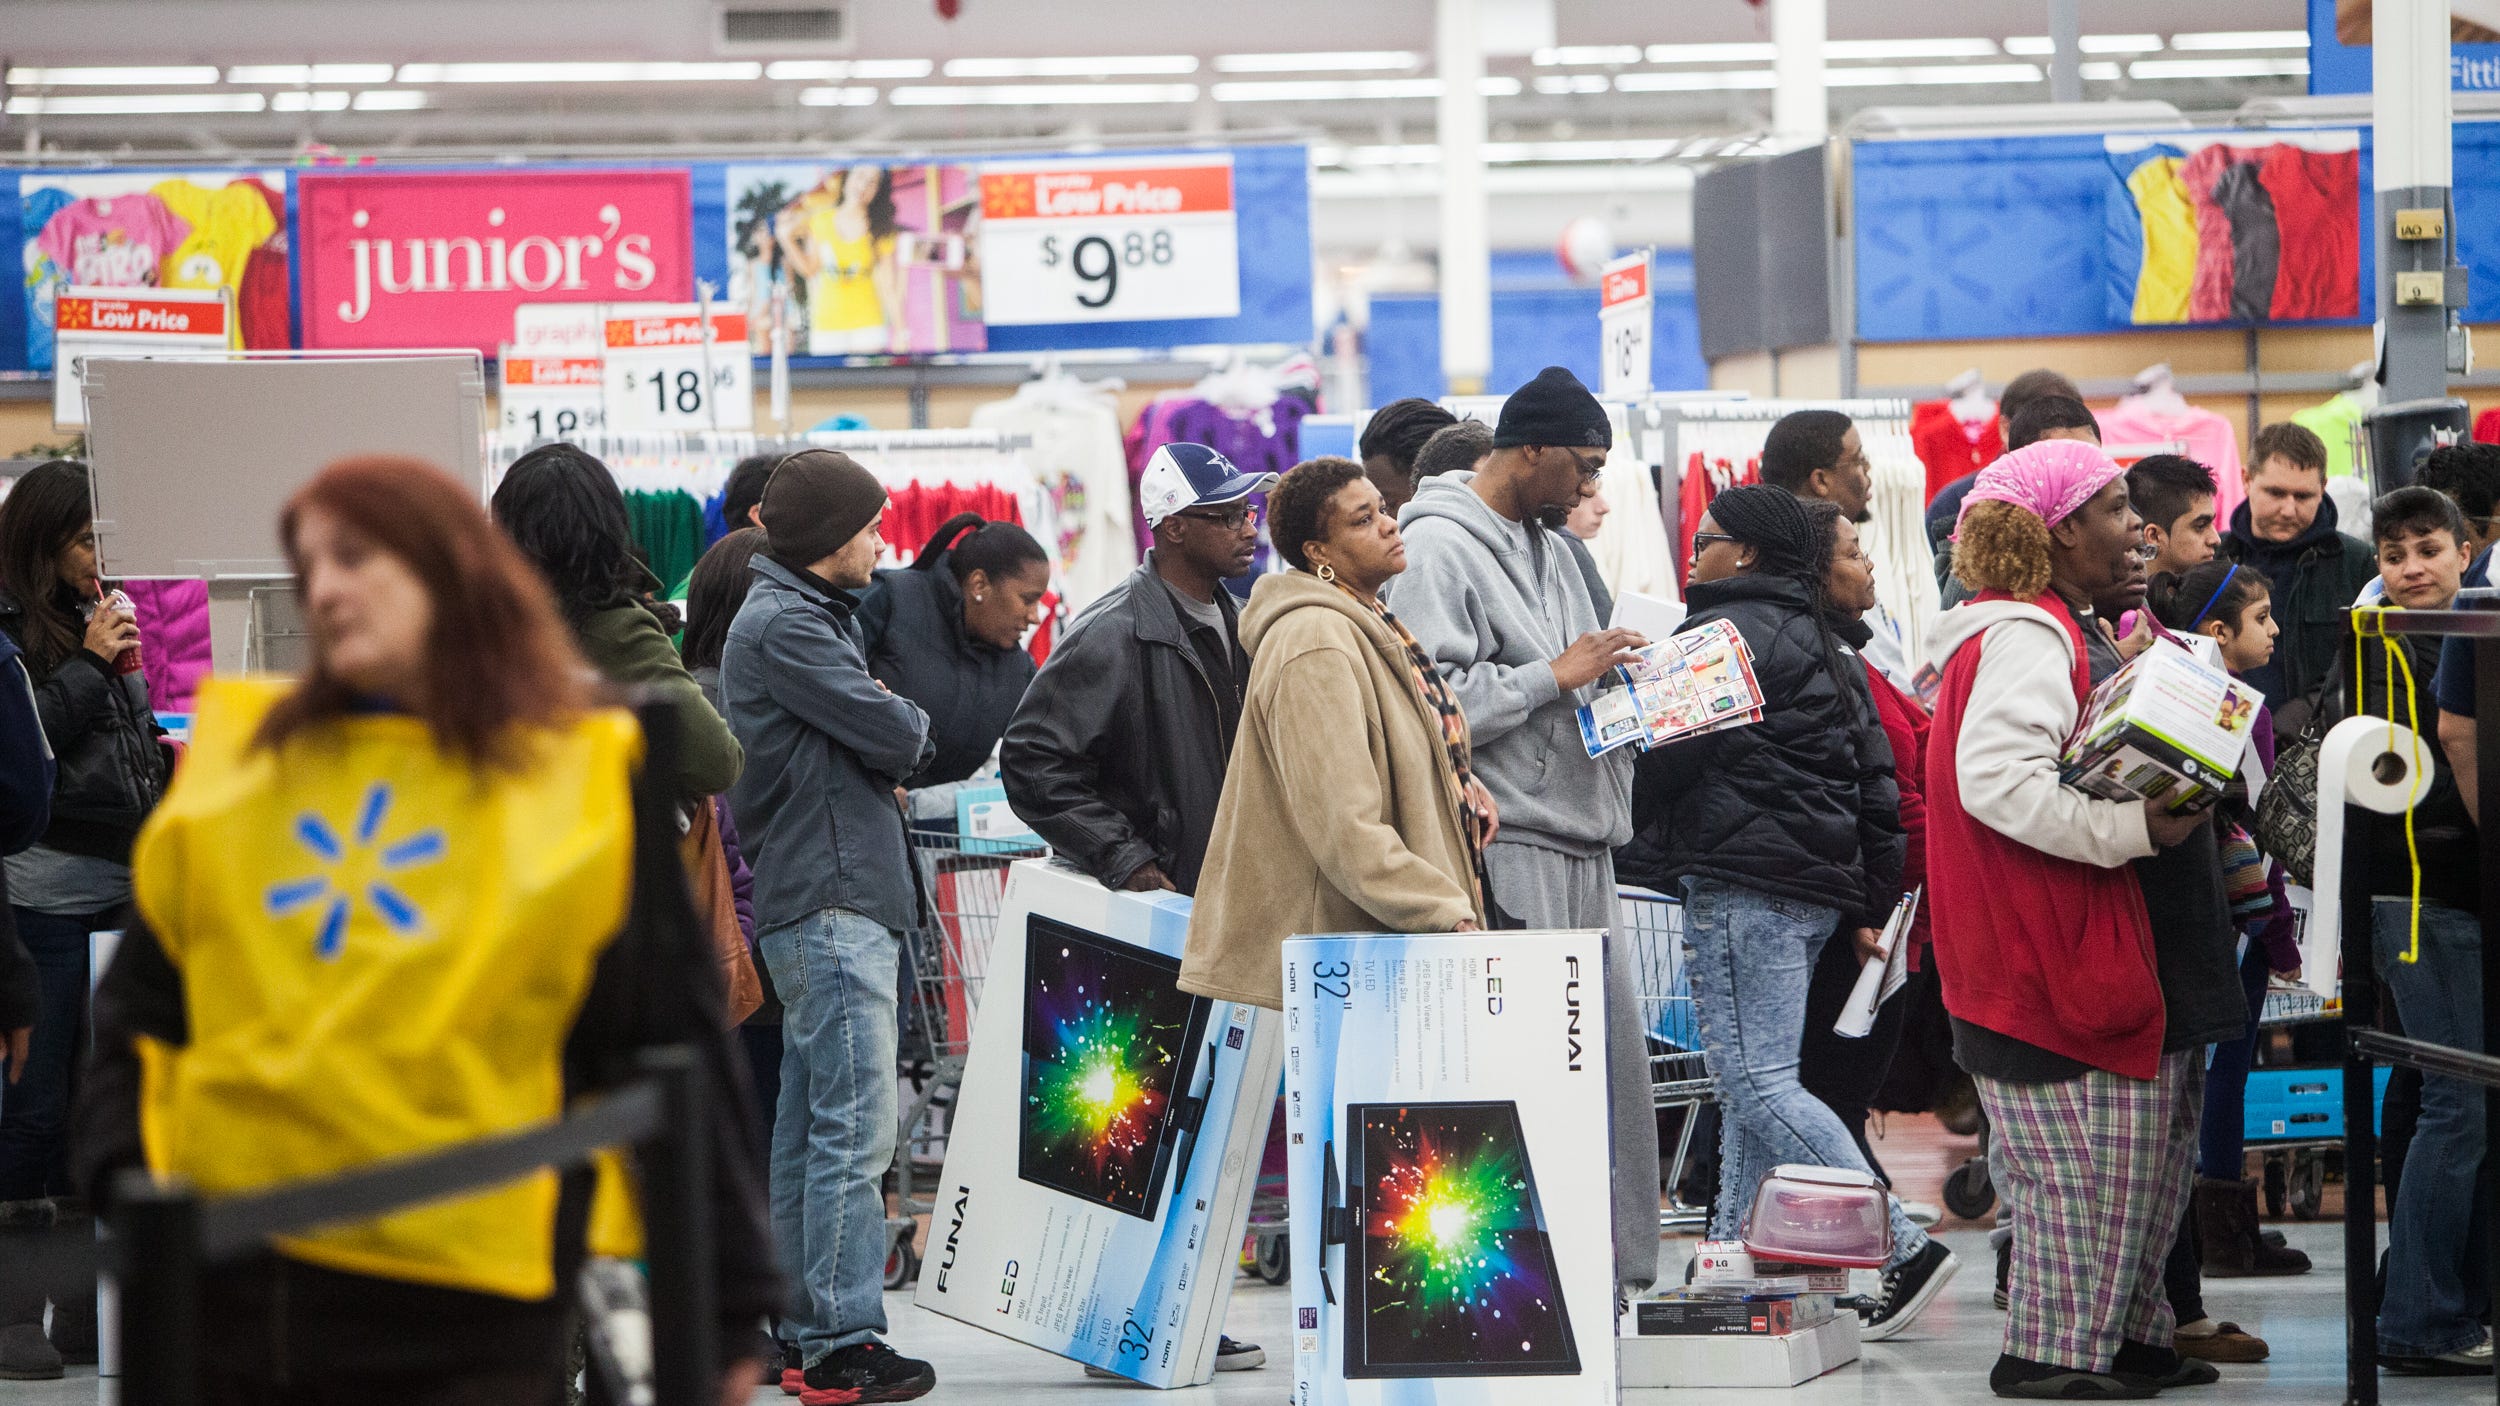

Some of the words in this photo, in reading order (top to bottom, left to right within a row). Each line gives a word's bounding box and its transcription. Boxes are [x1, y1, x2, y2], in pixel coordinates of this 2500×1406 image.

[1035, 187, 1101, 216] Low
[1103, 182, 1183, 212] Price
[92, 307, 135, 328] Low
[138, 309, 190, 331] Price
[633, 325, 671, 345] Low
[1364, 960, 1375, 972] TV
[1397, 959, 1407, 984] Energy
[1421, 959, 1430, 978] JPEG
[1445, 958, 1453, 967] PC
[1364, 974, 1376, 991] LED
[1445, 970, 1453, 990] Input
[1487, 957, 1502, 1016] LED
[1400, 987, 1408, 1002] Star
[1422, 981, 1431, 1002] Photo
[1423, 1004, 1431, 1030] Viewer
[1565, 956, 1581, 1072] FUNAI
[936, 1185, 969, 1293] FUNAI
[1716, 1259, 1728, 1267] LG
[996, 1259, 1018, 1314] LED
[1052, 1312, 1062, 1332] JPEG
[1057, 1290, 1067, 1311] Photo
[1062, 1264, 1074, 1289] Viewer
[1034, 1315, 1042, 1325] PC
[1071, 1314, 1083, 1338] Energy
[1077, 1297, 1086, 1312] Star
[1100, 1317, 1112, 1335] LED
[1097, 1335, 1108, 1347] TV
